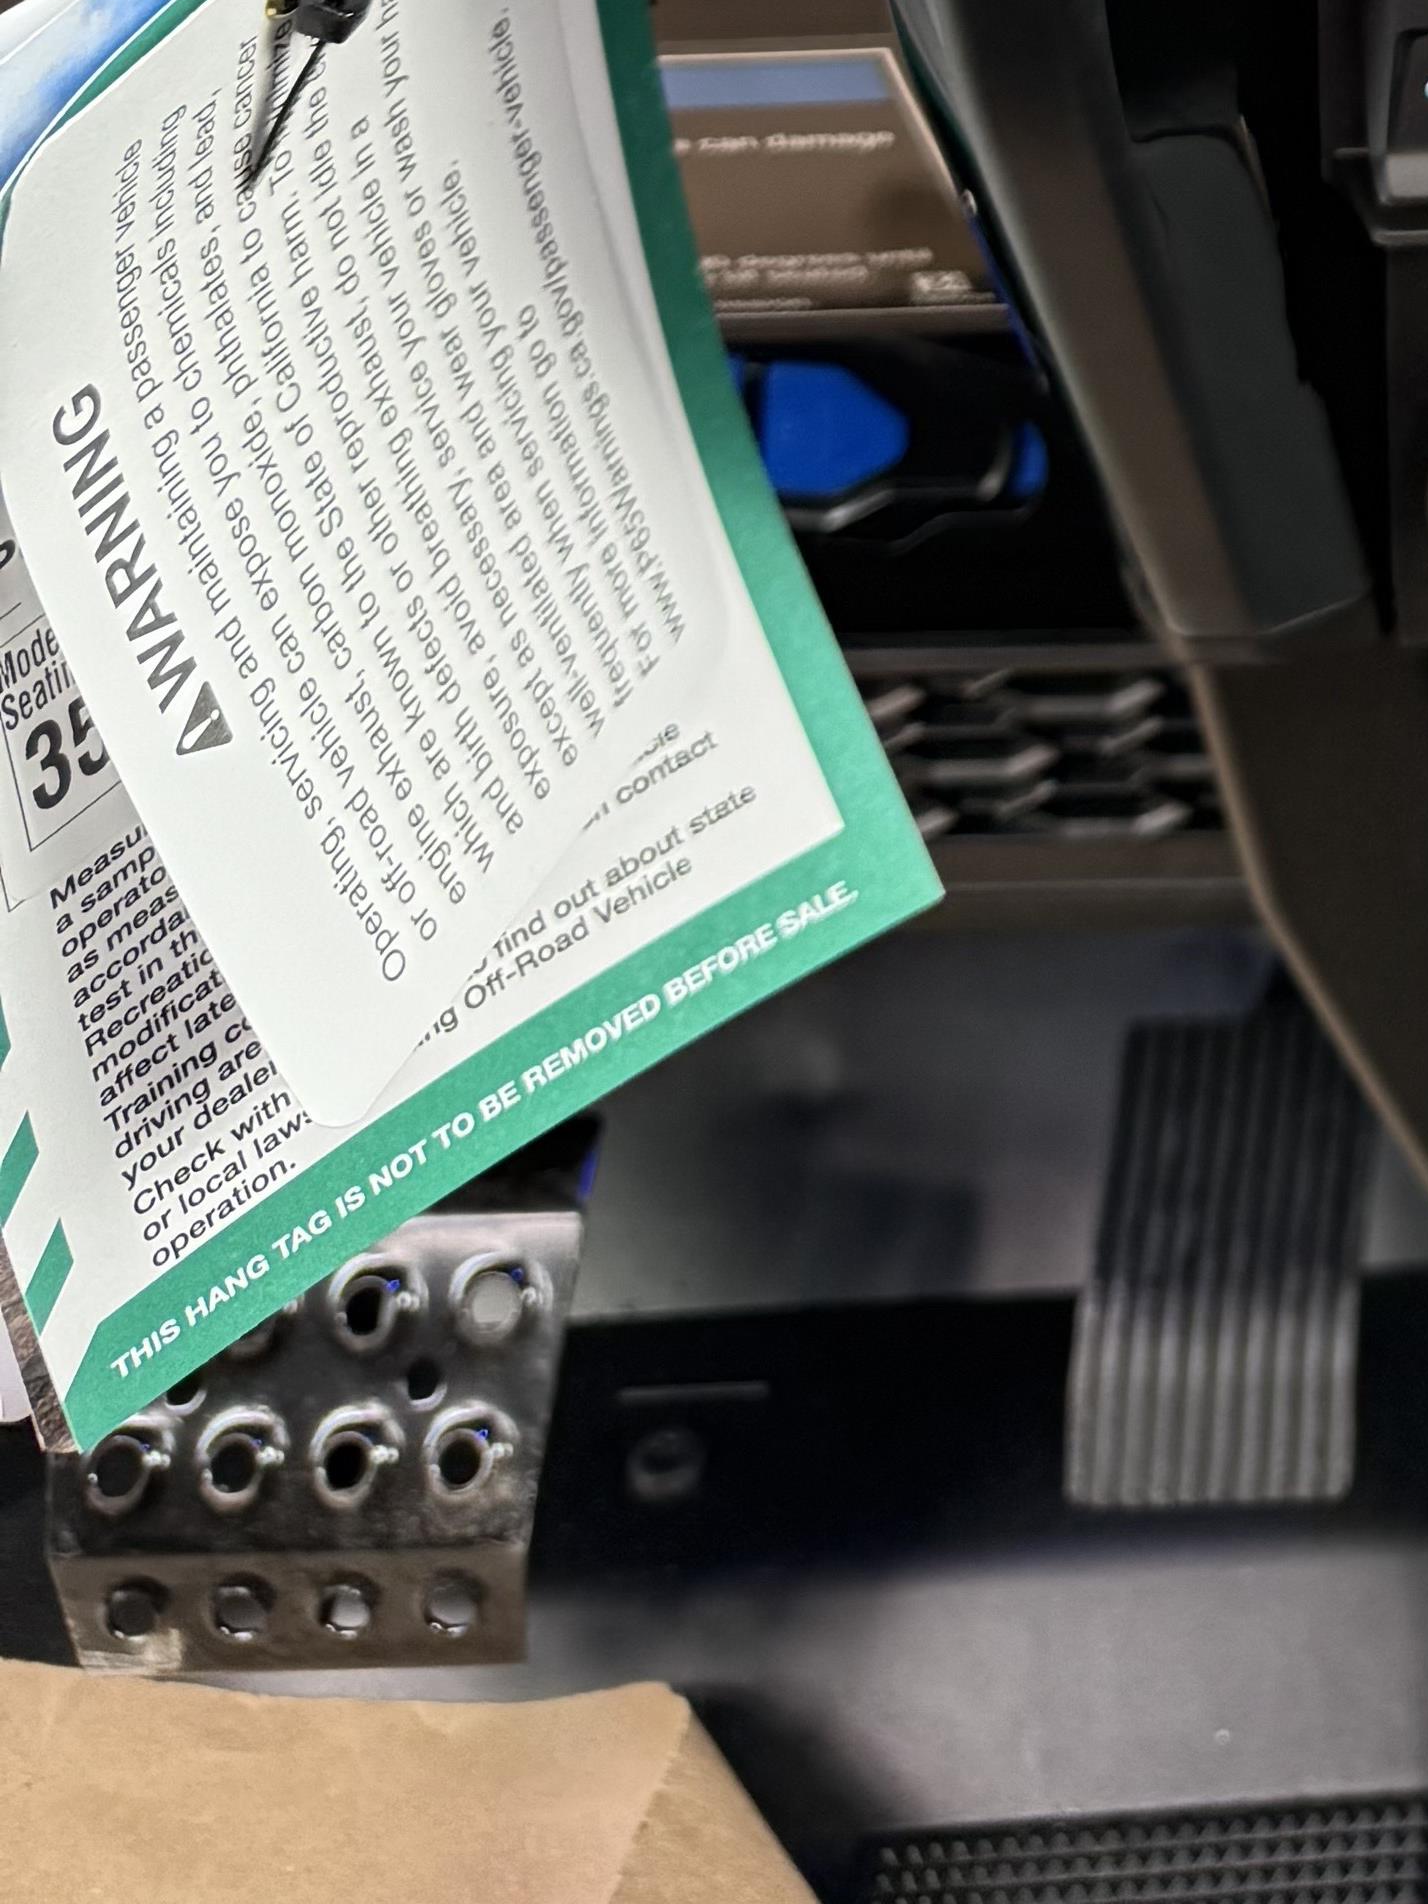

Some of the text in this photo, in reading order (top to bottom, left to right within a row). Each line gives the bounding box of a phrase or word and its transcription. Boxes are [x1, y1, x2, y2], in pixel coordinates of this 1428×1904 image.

[232, 36, 257, 130] cancer
[380, 31, 410, 98] your
[302, 86, 329, 141] the
[383, 97, 417, 183] wash
[308, 139, 338, 203] idle
[403, 186, 425, 218] or
[239, 227, 264, 266] to
[317, 195, 350, 252] not
[333, 254, 360, 296] do
[413, 220, 458, 320] gloves
[245, 262, 301, 413] California
[343, 295, 398, 428] exhaust,
[439, 325, 475, 402] wear
[283, 413, 314, 447] of
[350, 115, 578, 767] except as necessary, service your vehicle in a
[439, 159, 633, 709] frequently when servicing your vehicle.
[458, 400, 496, 460] and
[147, 104, 437, 942] or off-road vehicle can expose you to chemicals including
[186, 88, 466, 905] engine exhaust, carbon monoxide, phthalates, and lead,
[269, 150, 524, 835] and birth defects or other reproductive harm. To
[304, 450, 344, 538] State
[387, 427, 451, 579] breathing
[486, 461, 522, 531] area
[518, 304, 660, 678] For more information go to
[46, 383, 196, 714] WARNING
[110, 139, 406, 981] Operating, servicing and maintaining a passenger vehicle
[336, 536, 366, 594] the
[358, 591, 381, 631] to
[435, 572, 486, 656] avoid
[505, 533, 605, 739] well-ventilated
[373, 625, 426, 735] known
[419, 728, 451, 781] are
[482, 654, 550, 800] exposure,
[615, 731, 718, 805] contact
[442, 781, 494, 874] which
[553, 879, 600, 919] out
[605, 826, 684, 888] about
[689, 786, 756, 835] state
[464, 858, 692, 1009] Off-Road Vehicle
[77, 979, 133, 1032] test
[100, 1033, 180, 1107] affect
[103, 1041, 218, 1132] Training
[109, 879, 857, 1378] THIS HANG TAG IS NOT TO BE REMOVED BEFORE SALE.
[115, 1078, 211, 1159] driving
[121, 1125, 185, 1191] your
[133, 1092, 291, 1215] Check with
[143, 1150, 247, 1241] or local
[152, 1159, 297, 1267] operation.
